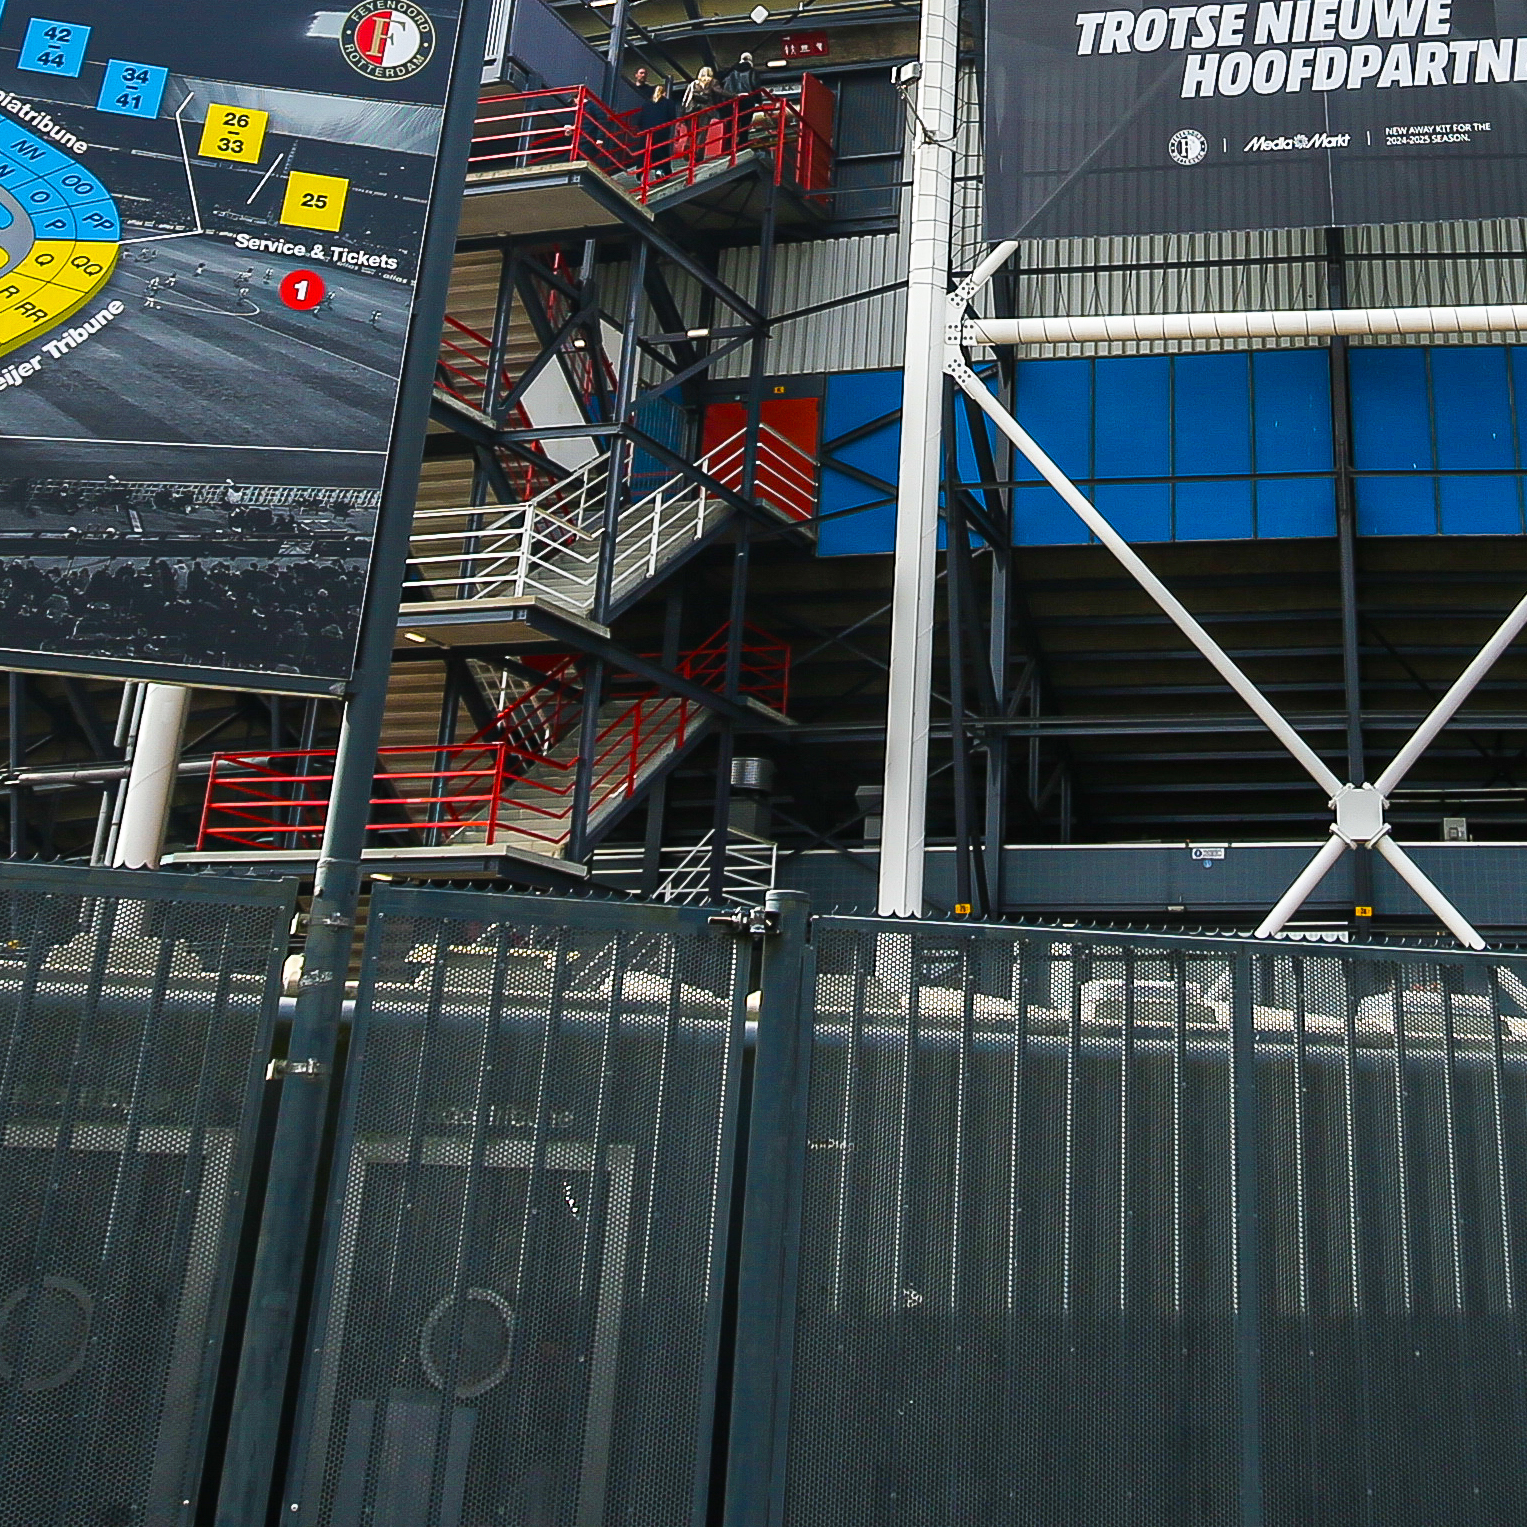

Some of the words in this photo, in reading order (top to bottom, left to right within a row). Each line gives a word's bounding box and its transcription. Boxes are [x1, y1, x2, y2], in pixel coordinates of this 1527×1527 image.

[43, 27, 71, 44] 42
[366, 16, 406, 57] F
[1075, 3, 1247, 56] TROTSE
[36, 52, 64, 69] 44
[344, 42, 426, 79] ROTTERDAM
[121, 67, 149, 84] 34
[114, 94, 141, 111] 41
[222, 113, 250, 129] 26
[1386, 127, 1407, 136] NEW
[1409, 126, 1434, 134] AWAY
[1435, 124, 1451, 133] KIT
[1453, 123, 1472, 132] FOR
[1473, 122, 1491, 131] THE
[10, 138, 45, 161] NN
[216, 137, 245, 154] 33
[1307, 133, 1351, 149] Markt
[61, 174, 93, 195] OO
[300, 193, 328, 209] 25
[44, 218, 66, 231] P
[82, 212, 114, 230] PP
[33, 252, 55, 267] Q
[235, 232, 306, 257] Service
[309, 244, 327, 259] &
[330, 246, 398, 270] Tickets
[70, 255, 104, 276] QQ
[293, 279, 309, 300] 1
[13, 302, 48, 322] RR
[43, 298, 125, 359] Tribune
